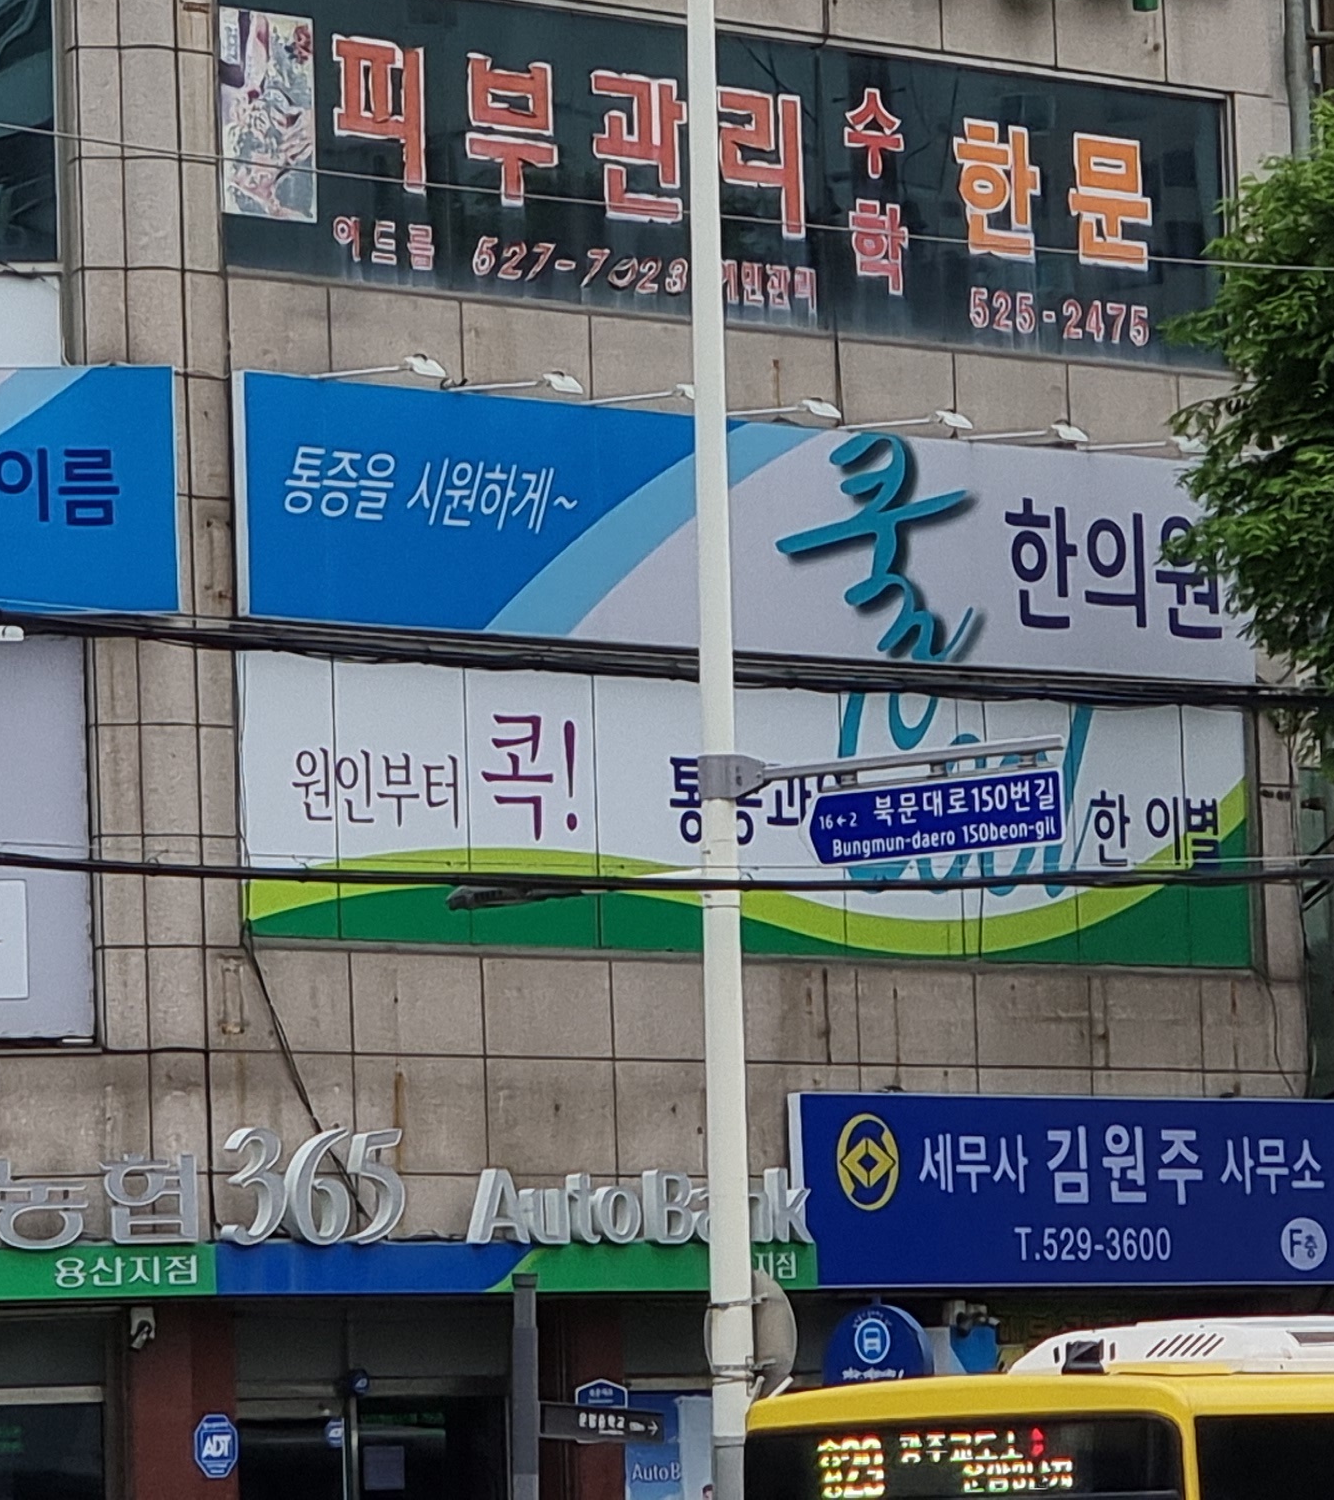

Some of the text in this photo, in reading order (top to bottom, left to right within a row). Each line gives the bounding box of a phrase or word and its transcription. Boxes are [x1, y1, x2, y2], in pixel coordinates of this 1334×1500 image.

[330, 33, 1153, 297] 피부관리 수학 한문
[471, 235, 690, 296] 527-7023
[967, 288, 1151, 348] 525-2475
[282, 443, 579, 536] 통증을 시원하게~
[1003, 499, 1223, 640] 한의원
[289, 744, 461, 824] 원인부터
[480, 713, 581, 841] 콕!
[873, 778, 1056, 828] 북문대로150번길
[831, 815, 1057, 859] Bungmun-daero 150beon-gil
[1145, 796, 1220, 870] 이별
[220, 1126, 407, 1247] 365
[918, 1124, 1326, 1206] 세무사 김원주 사무소
[53, 1253, 199, 1290] 용산지점
[1013, 1225, 1173, 1263] T.529-3600
[201, 1434, 232, 1459] ADT
[630, 1461, 682, 1483] AutoB
